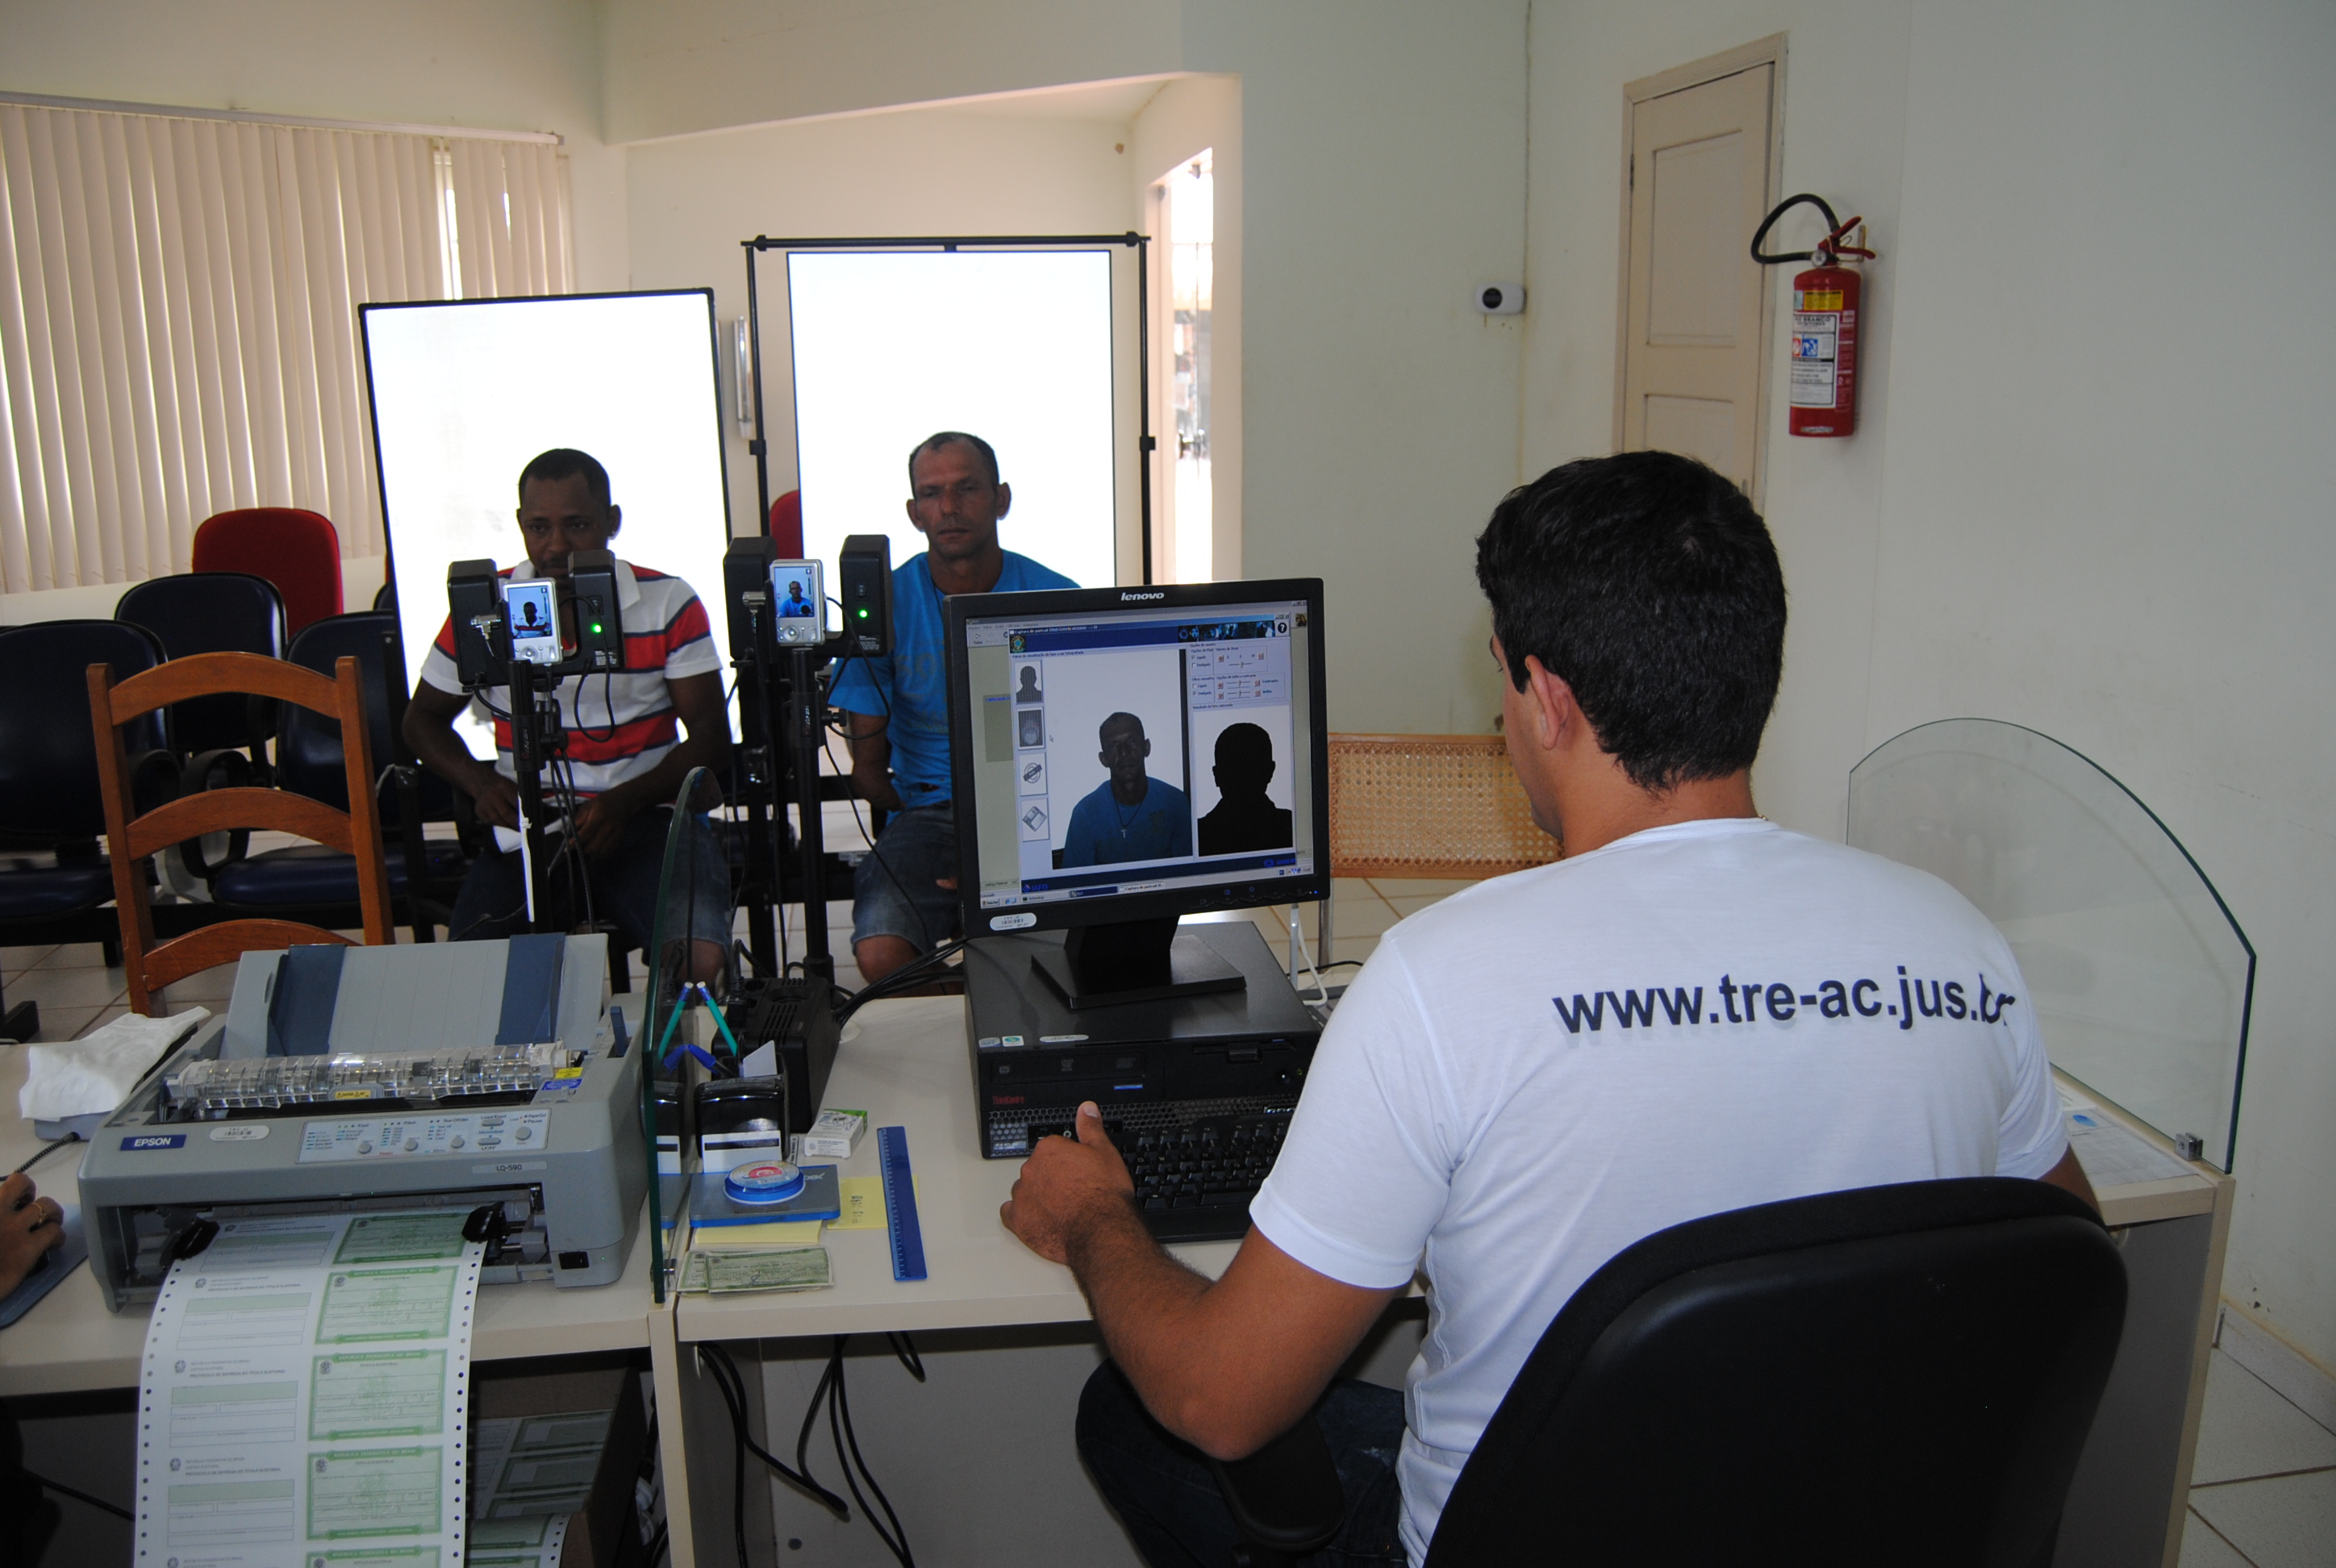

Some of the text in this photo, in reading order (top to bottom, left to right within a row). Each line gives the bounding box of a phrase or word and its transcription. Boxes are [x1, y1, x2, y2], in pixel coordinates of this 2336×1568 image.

[1120, 592, 1166, 602] lenovo
[1551, 965, 2016, 1035] www.tre-ac.jus.br
[134, 1136, 172, 1147] EPSON
[496, 1164, 523, 1172] LQ-590
